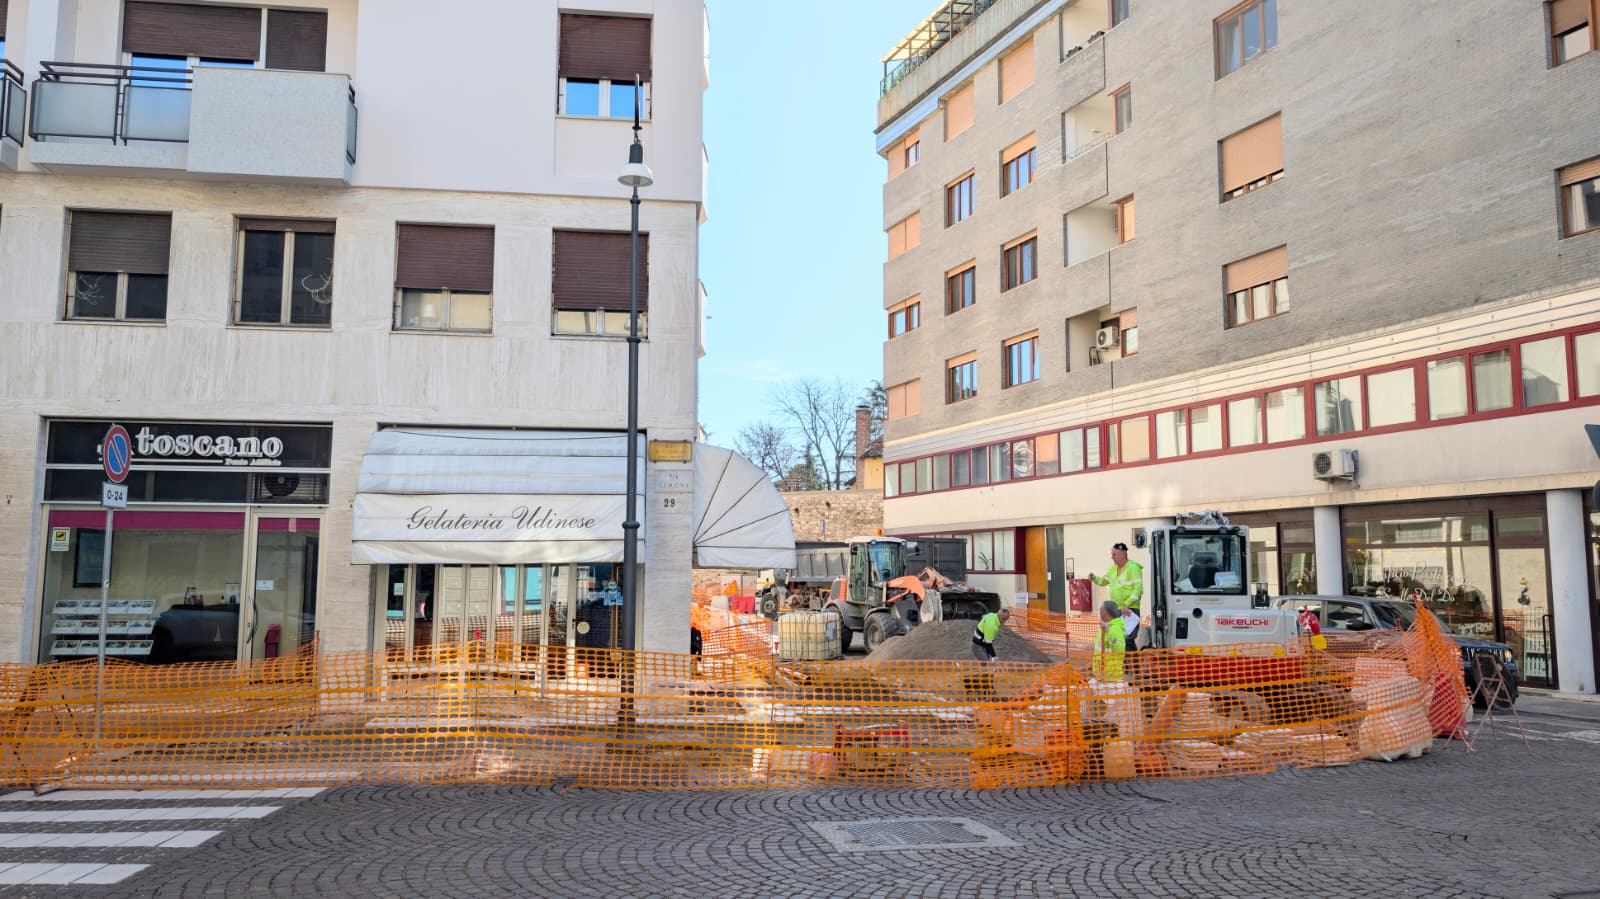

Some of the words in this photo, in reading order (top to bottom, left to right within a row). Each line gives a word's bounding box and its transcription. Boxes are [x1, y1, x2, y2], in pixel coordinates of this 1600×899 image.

[135, 426, 284, 458] toscano
[106, 489, 124, 501] 0-24
[663, 498, 676, 508] 29
[407, 505, 504, 530] Gelateria
[511, 505, 596, 530] Udinese
